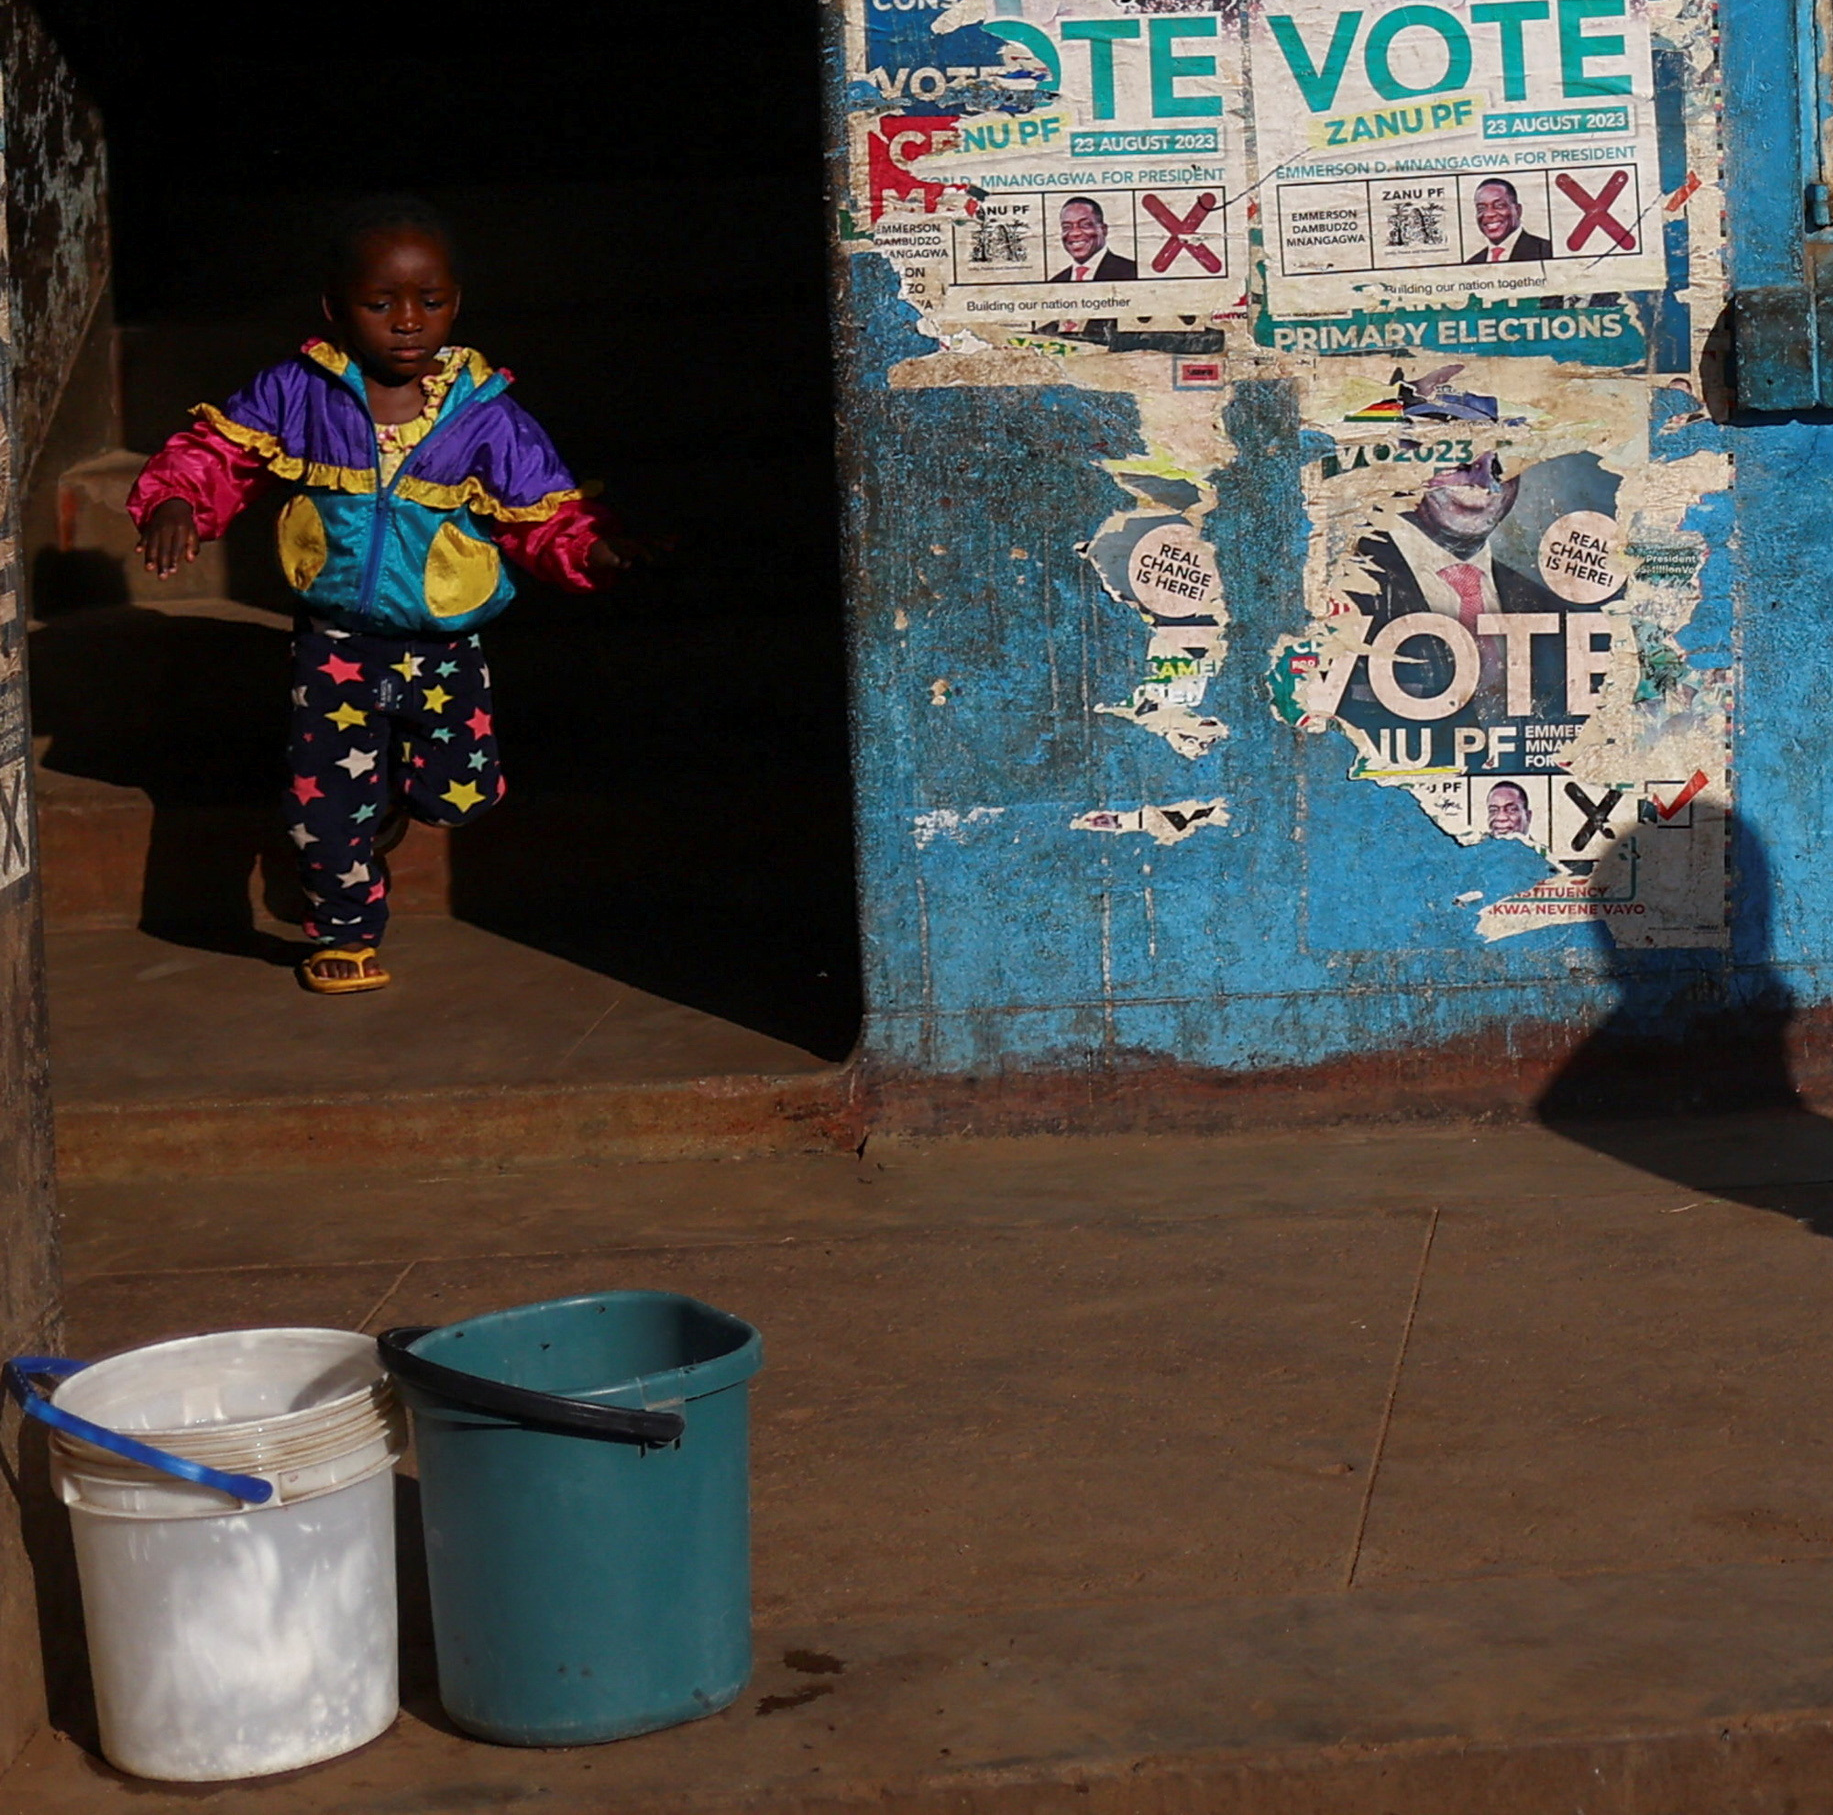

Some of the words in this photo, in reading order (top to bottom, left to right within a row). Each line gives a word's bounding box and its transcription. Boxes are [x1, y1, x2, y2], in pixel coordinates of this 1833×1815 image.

[1273, 322, 1427, 352] PRIMARY
[1438, 312, 1623, 345] ELECTIONS
[1140, 552, 1212, 588] CHANGE
[1160, 542, 1201, 568] REAL
[1136, 568, 1158, 585] IS
[1160, 571, 1206, 602] HERE!
[1535, 901, 1598, 918] NEVENE
[1602, 902, 1645, 917] VAYO
